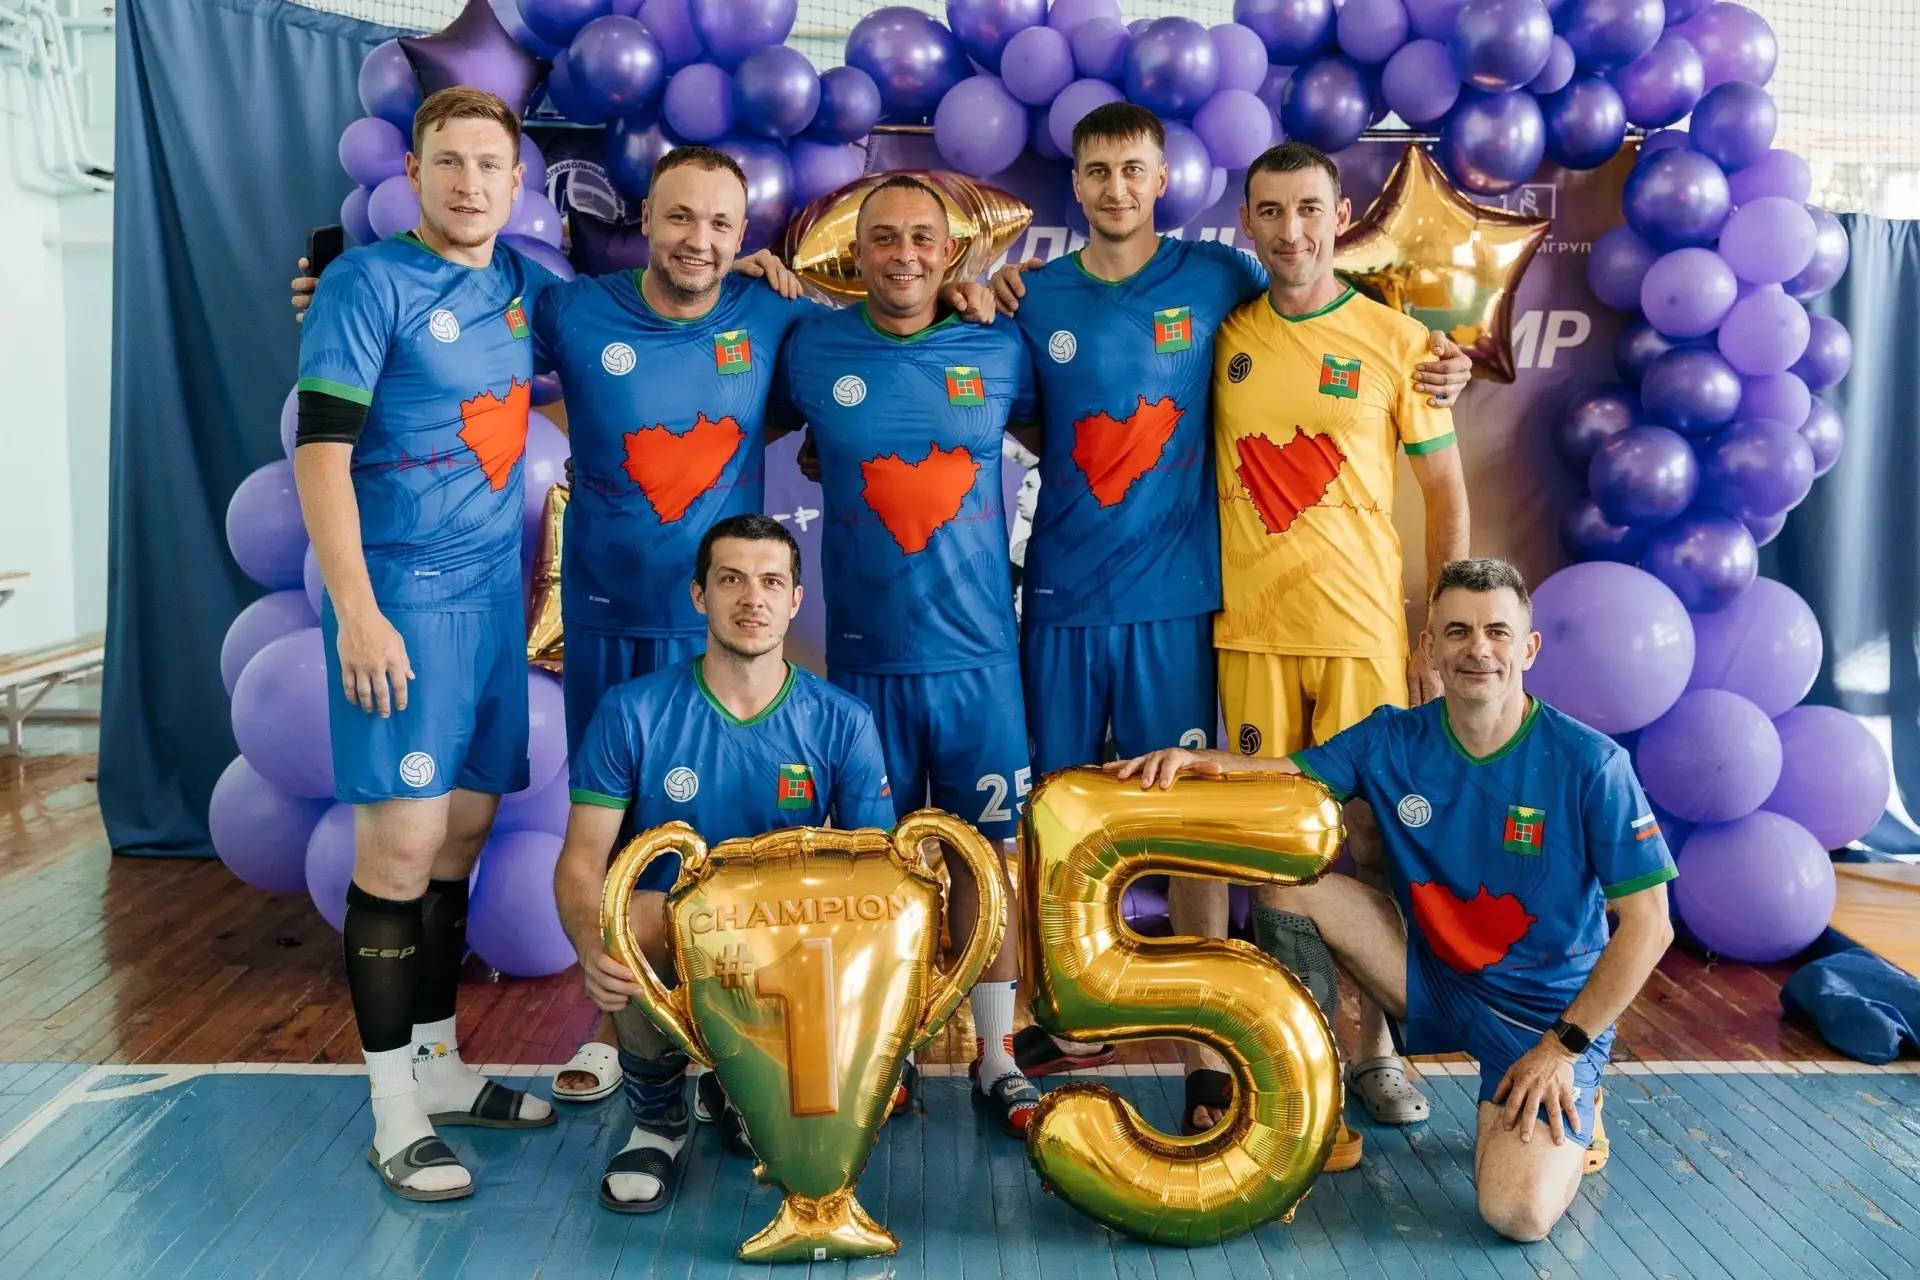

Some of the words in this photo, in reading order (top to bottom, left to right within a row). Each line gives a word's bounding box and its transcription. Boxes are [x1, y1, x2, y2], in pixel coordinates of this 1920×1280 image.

[545, 161, 606, 180] ОЛЕЙБОЛЬНЫ
[1537, 234, 1592, 253] ЙГРУП
[975, 765, 1032, 823] 25
[688, 895, 915, 934] CHAMPION
[1022, 766, 1346, 1249] 5
[412, 1053, 436, 1064] OLLEY
